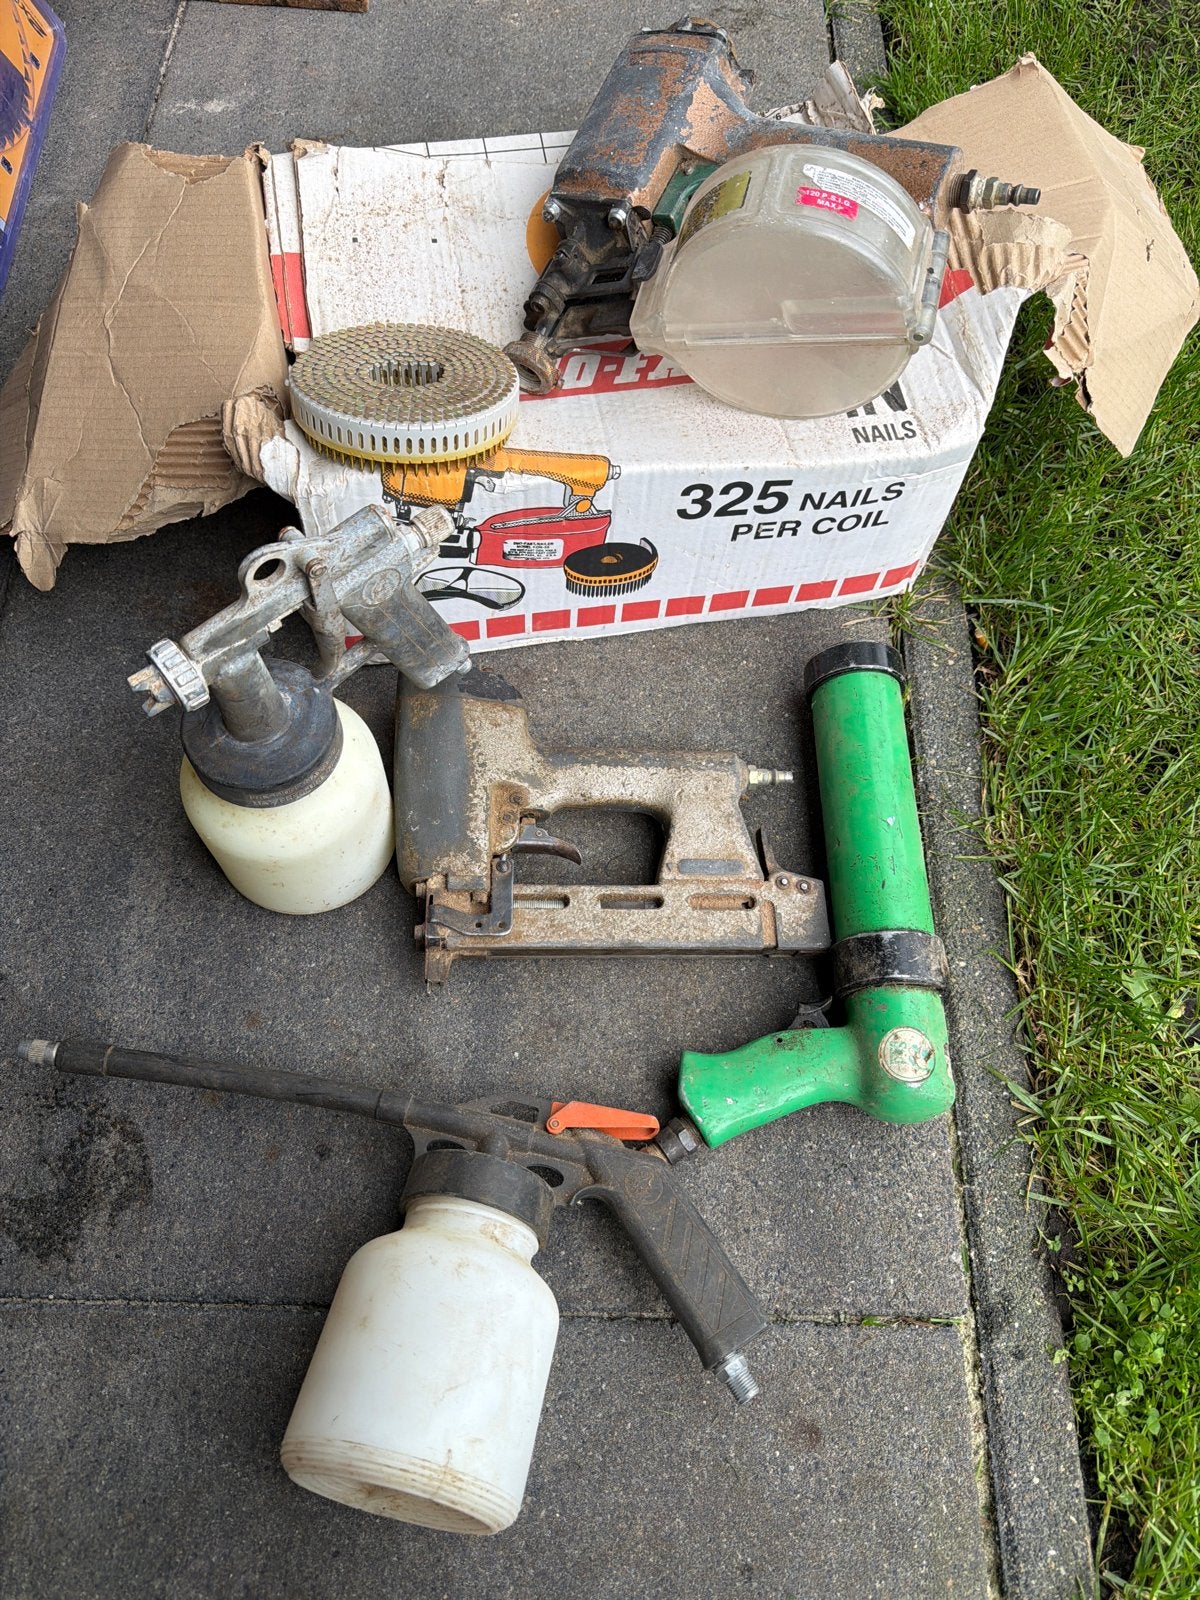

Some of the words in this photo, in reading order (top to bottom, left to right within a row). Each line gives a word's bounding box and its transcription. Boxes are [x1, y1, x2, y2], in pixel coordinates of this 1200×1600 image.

[851, 420, 917, 444] NAILS
[676, 479, 793, 520] 325
[800, 482, 906, 511] NAILS
[730, 520, 802, 542] PER
[811, 510, 889, 535] COIL
